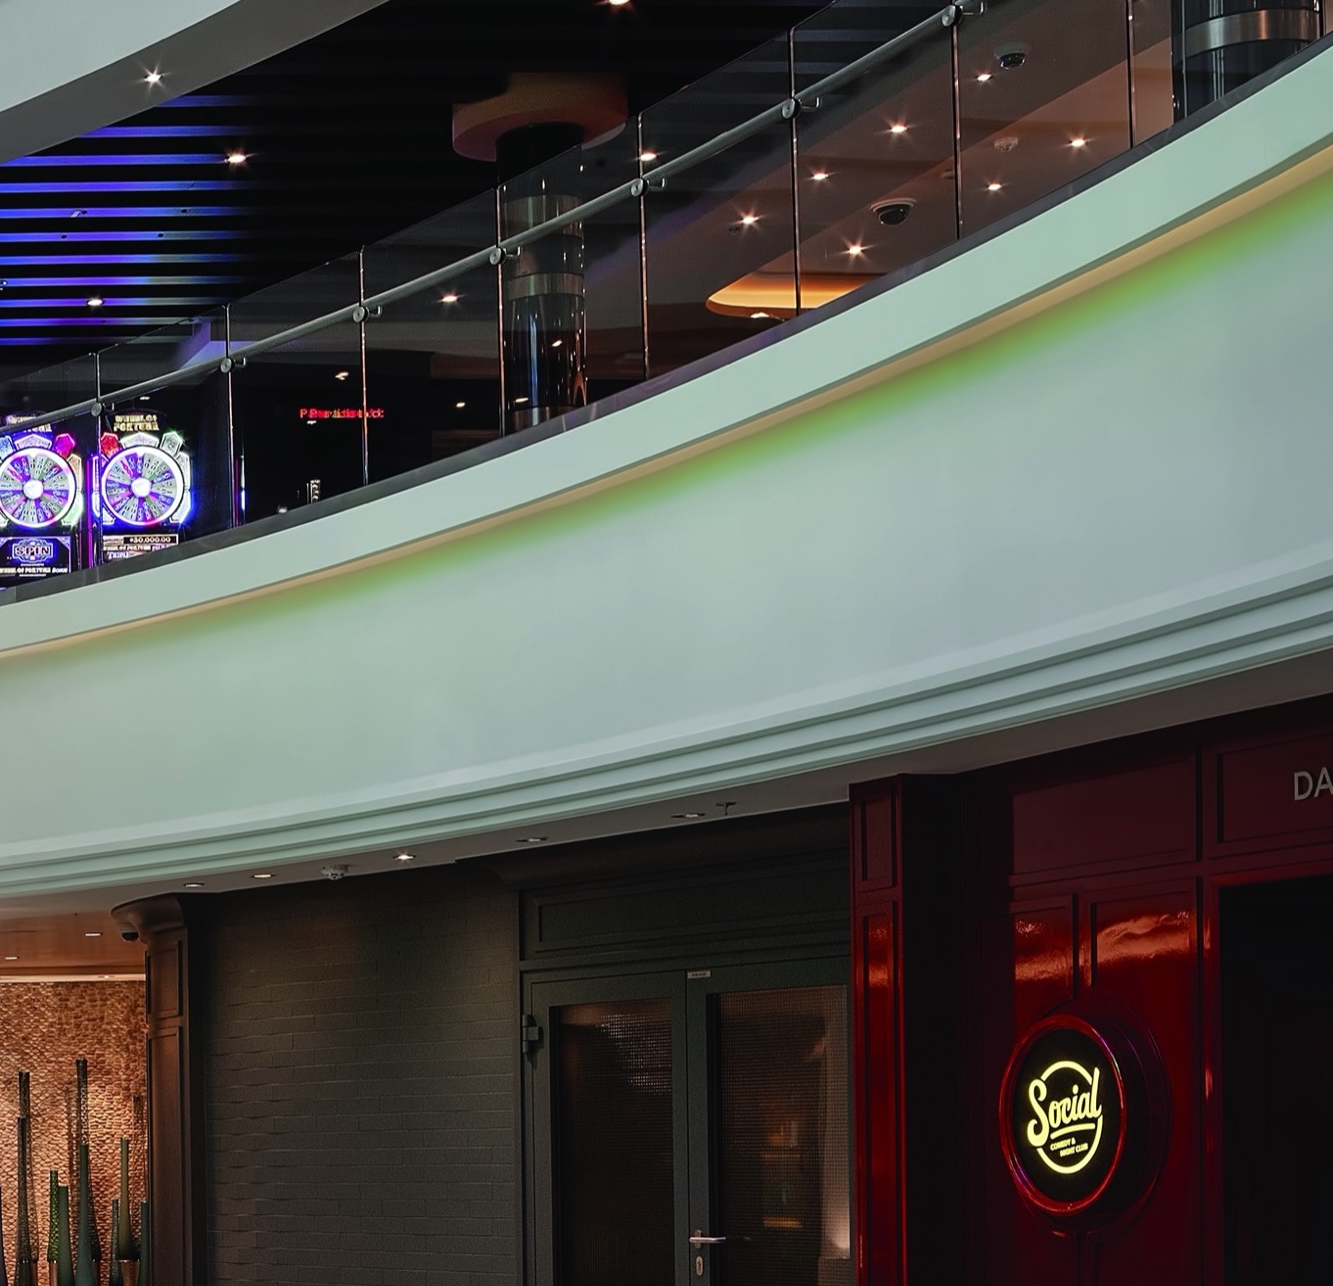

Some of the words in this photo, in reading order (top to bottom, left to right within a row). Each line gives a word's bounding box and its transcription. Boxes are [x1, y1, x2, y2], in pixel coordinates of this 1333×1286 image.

[15, 546, 50, 556] SPIN
[1294, 766, 1333, 801] DA
[1027, 1066, 1102, 1148] Social
